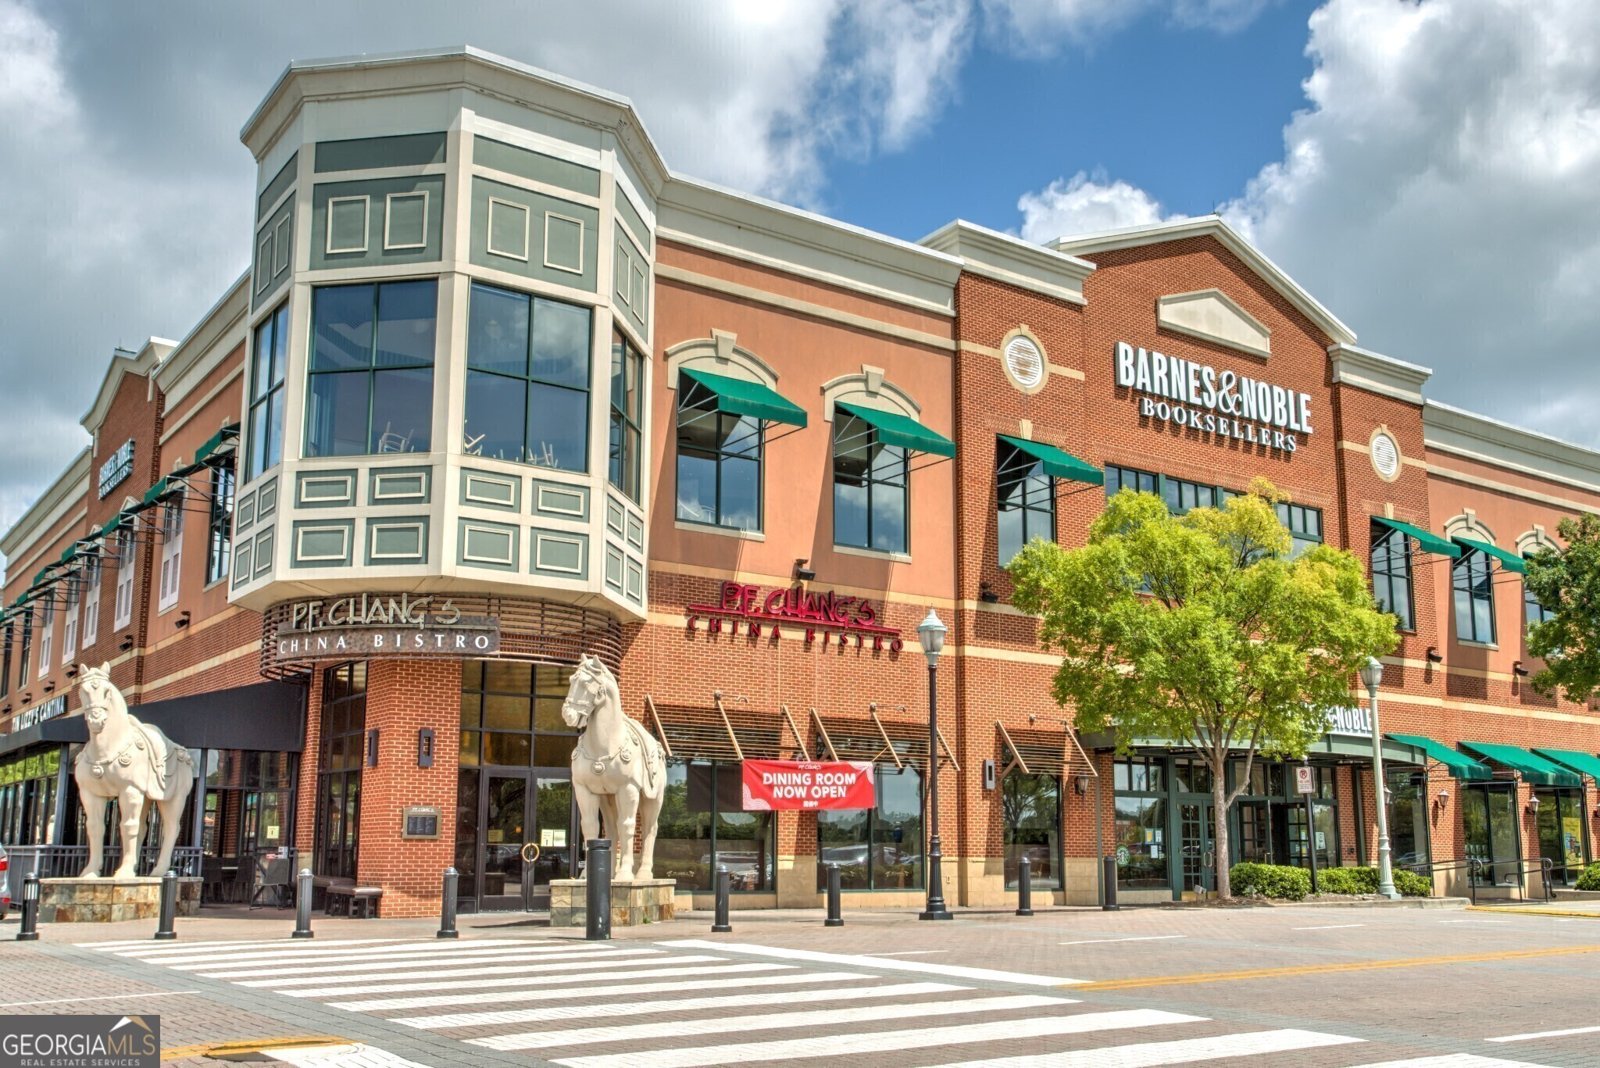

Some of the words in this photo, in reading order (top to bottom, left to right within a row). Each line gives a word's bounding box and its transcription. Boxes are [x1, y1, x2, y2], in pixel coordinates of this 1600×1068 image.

[1140, 397, 1296, 451] BOOKSELLERS
[292, 600, 324, 633] P.F.
[280, 634, 346, 654] CHINA
[373, 633, 489, 649] BISTRO
[687, 616, 781, 640] CHINA
[805, 628, 904, 653] BISTRO
[762, 772, 812, 785] DINING
[815, 773, 857, 785] ROOM
[772, 786, 807, 798] NOW
[811, 786, 847, 798] OPEN
